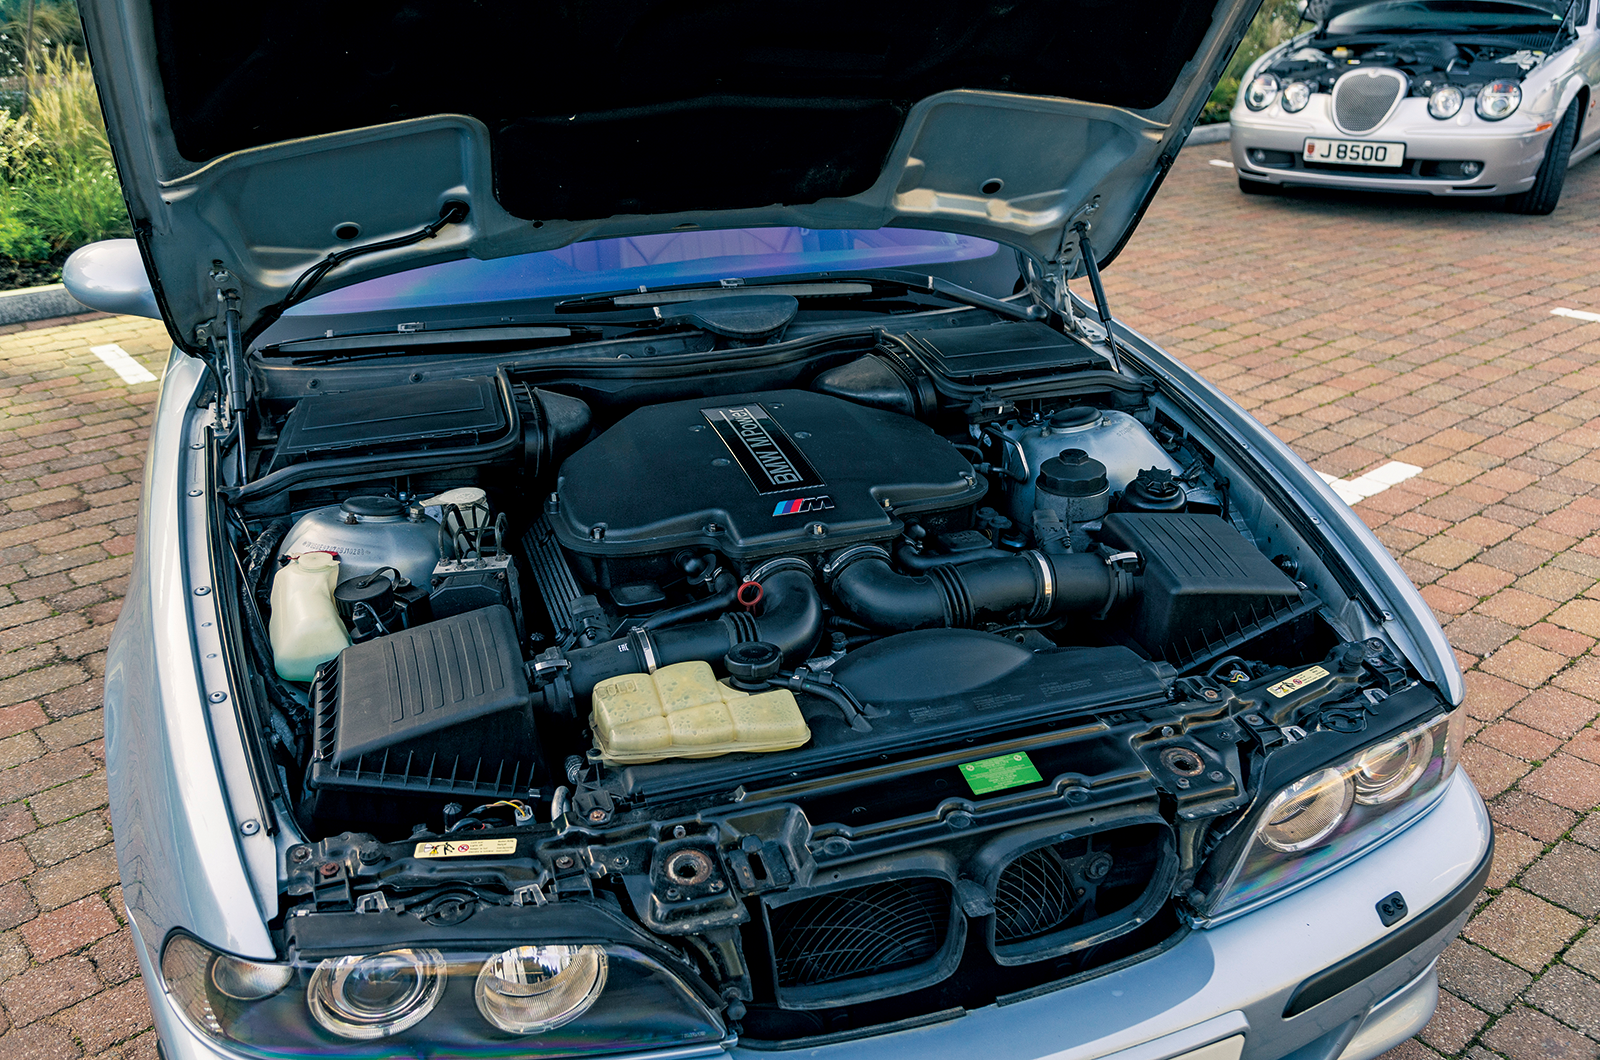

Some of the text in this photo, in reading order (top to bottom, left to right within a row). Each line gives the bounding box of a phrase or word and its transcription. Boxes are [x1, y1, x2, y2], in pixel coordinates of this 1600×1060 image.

[1320, 142, 1388, 162] J 8500
[755, 451, 799, 485] BMW
